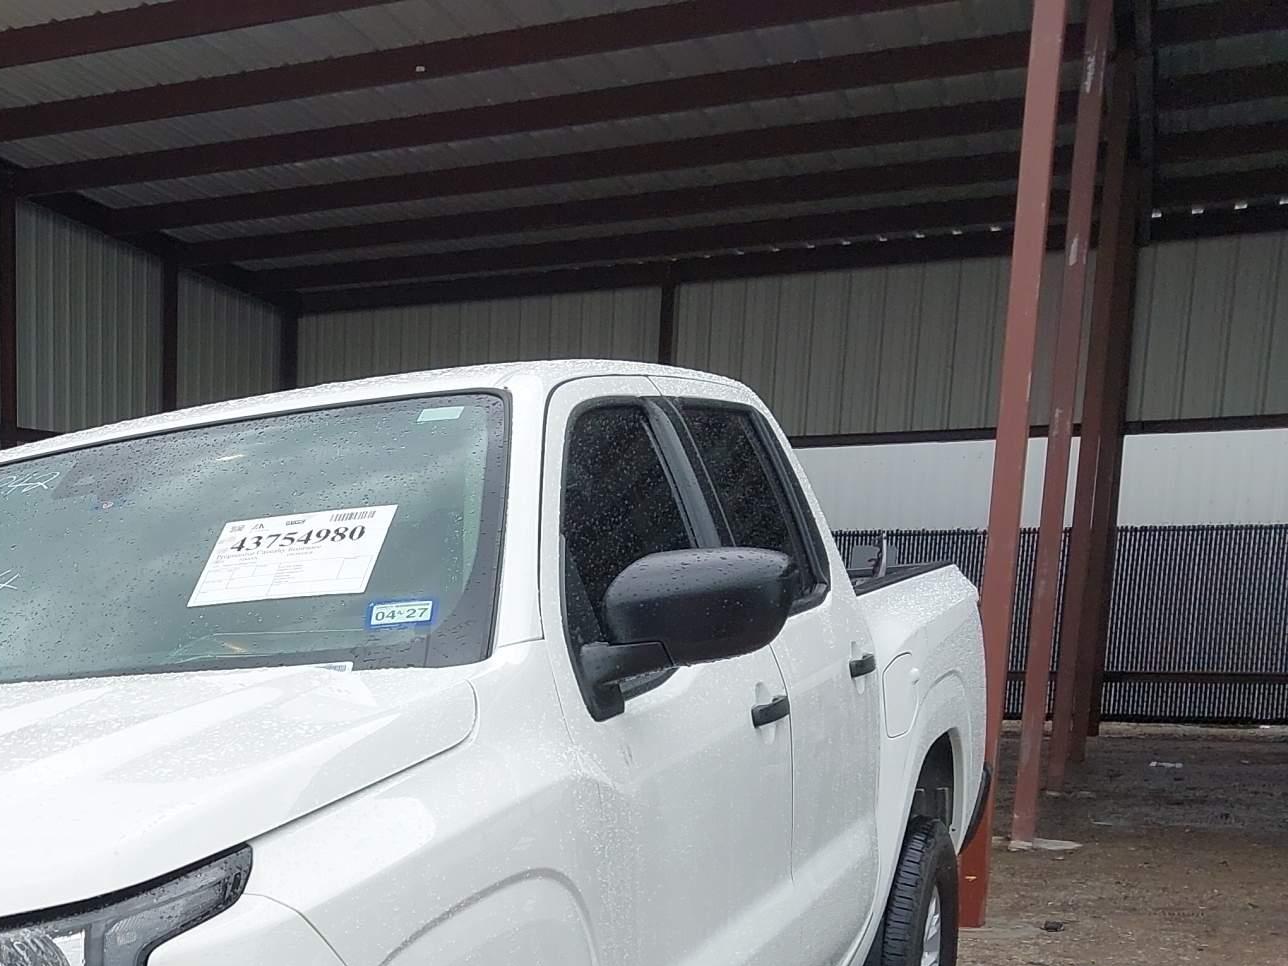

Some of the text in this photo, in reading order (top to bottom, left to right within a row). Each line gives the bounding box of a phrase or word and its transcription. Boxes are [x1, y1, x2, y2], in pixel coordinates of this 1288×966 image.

[230, 523, 366, 552] 43754980
[375, 607, 429, 622] 04 27
